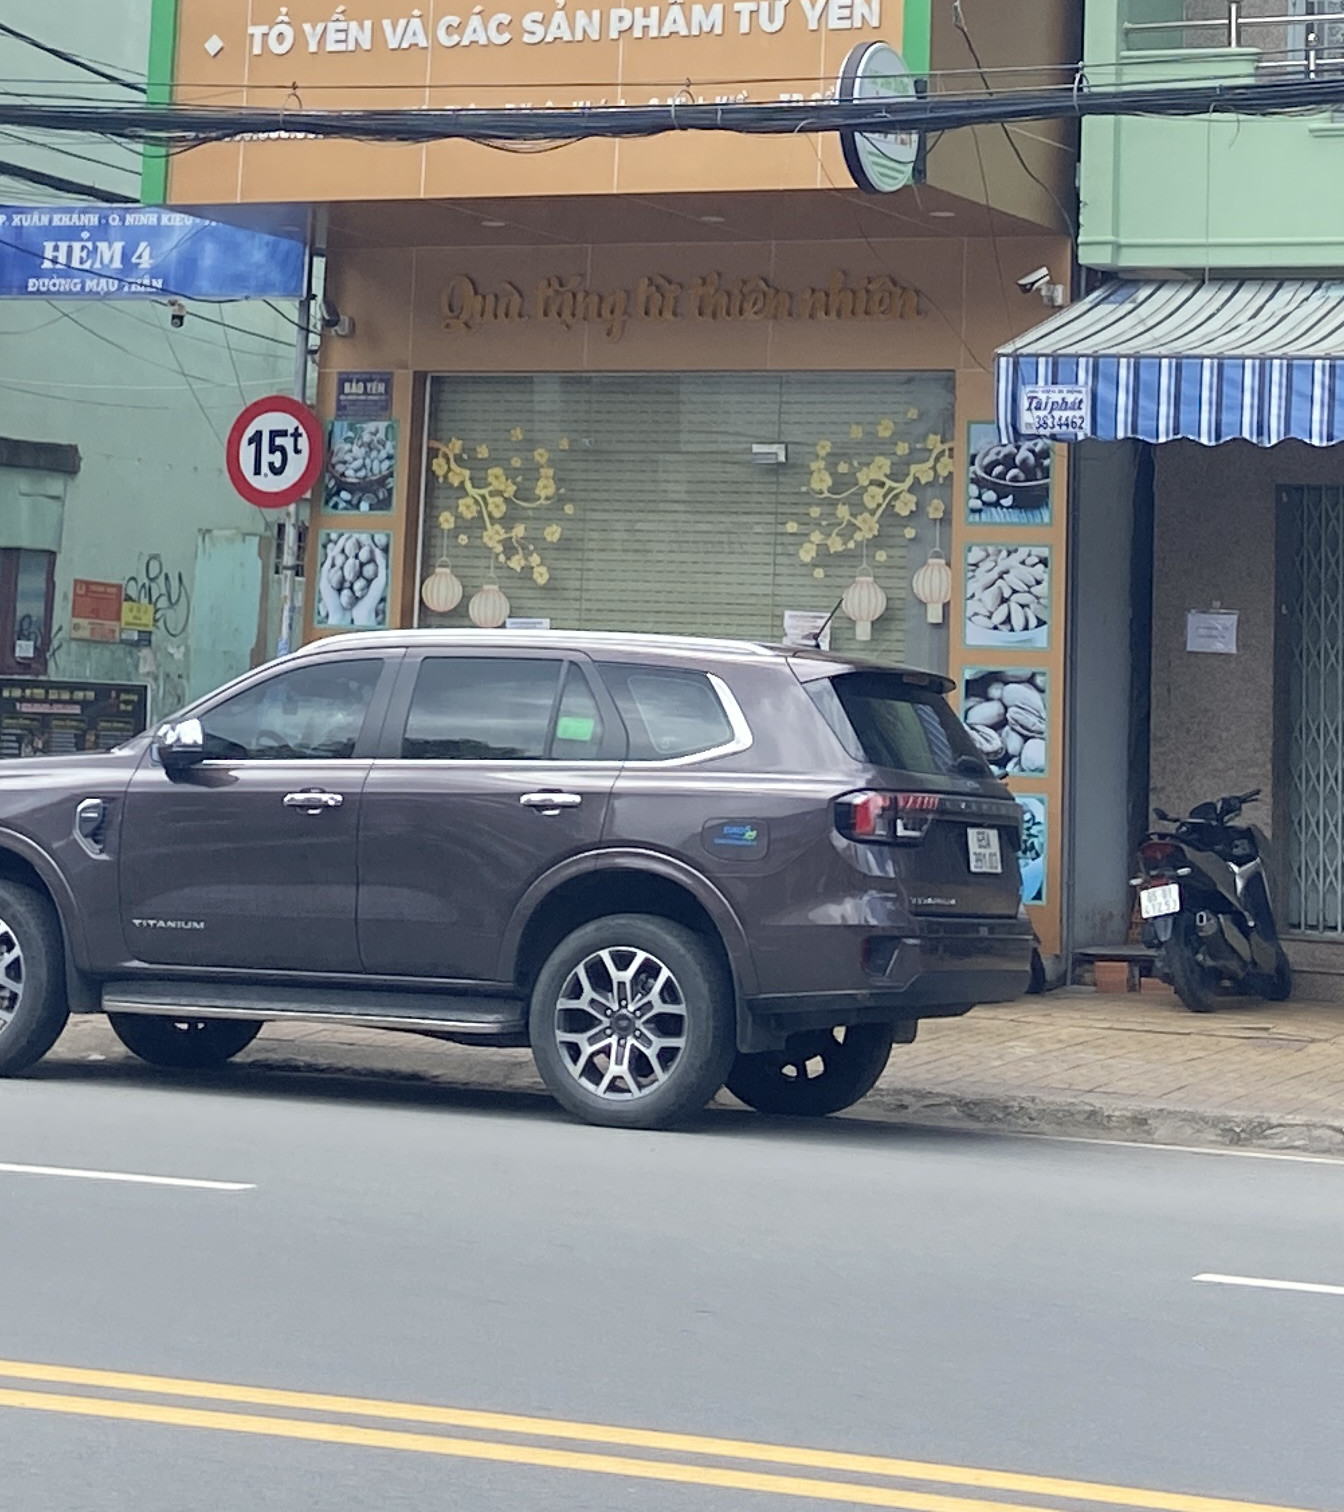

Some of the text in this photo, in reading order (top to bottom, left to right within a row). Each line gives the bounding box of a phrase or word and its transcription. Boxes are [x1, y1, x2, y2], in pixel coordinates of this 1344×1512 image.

[301, 4, 374, 54] YẾN
[381, 8, 429, 51] VÀ
[436, 4, 514, 49] CÁC
[11, 211, 51, 226] XUÂN
[52, 210, 100, 226] KHÁNH
[125, 212, 158, 226] NINH
[40, 230, 155, 269] HẺM 4
[27, 273, 82, 292] ĐƯỜNG
[84, 278, 119, 296] MẬU
[799, 268, 928, 322] nhiên
[131, 918, 206, 931] TITANIUM
